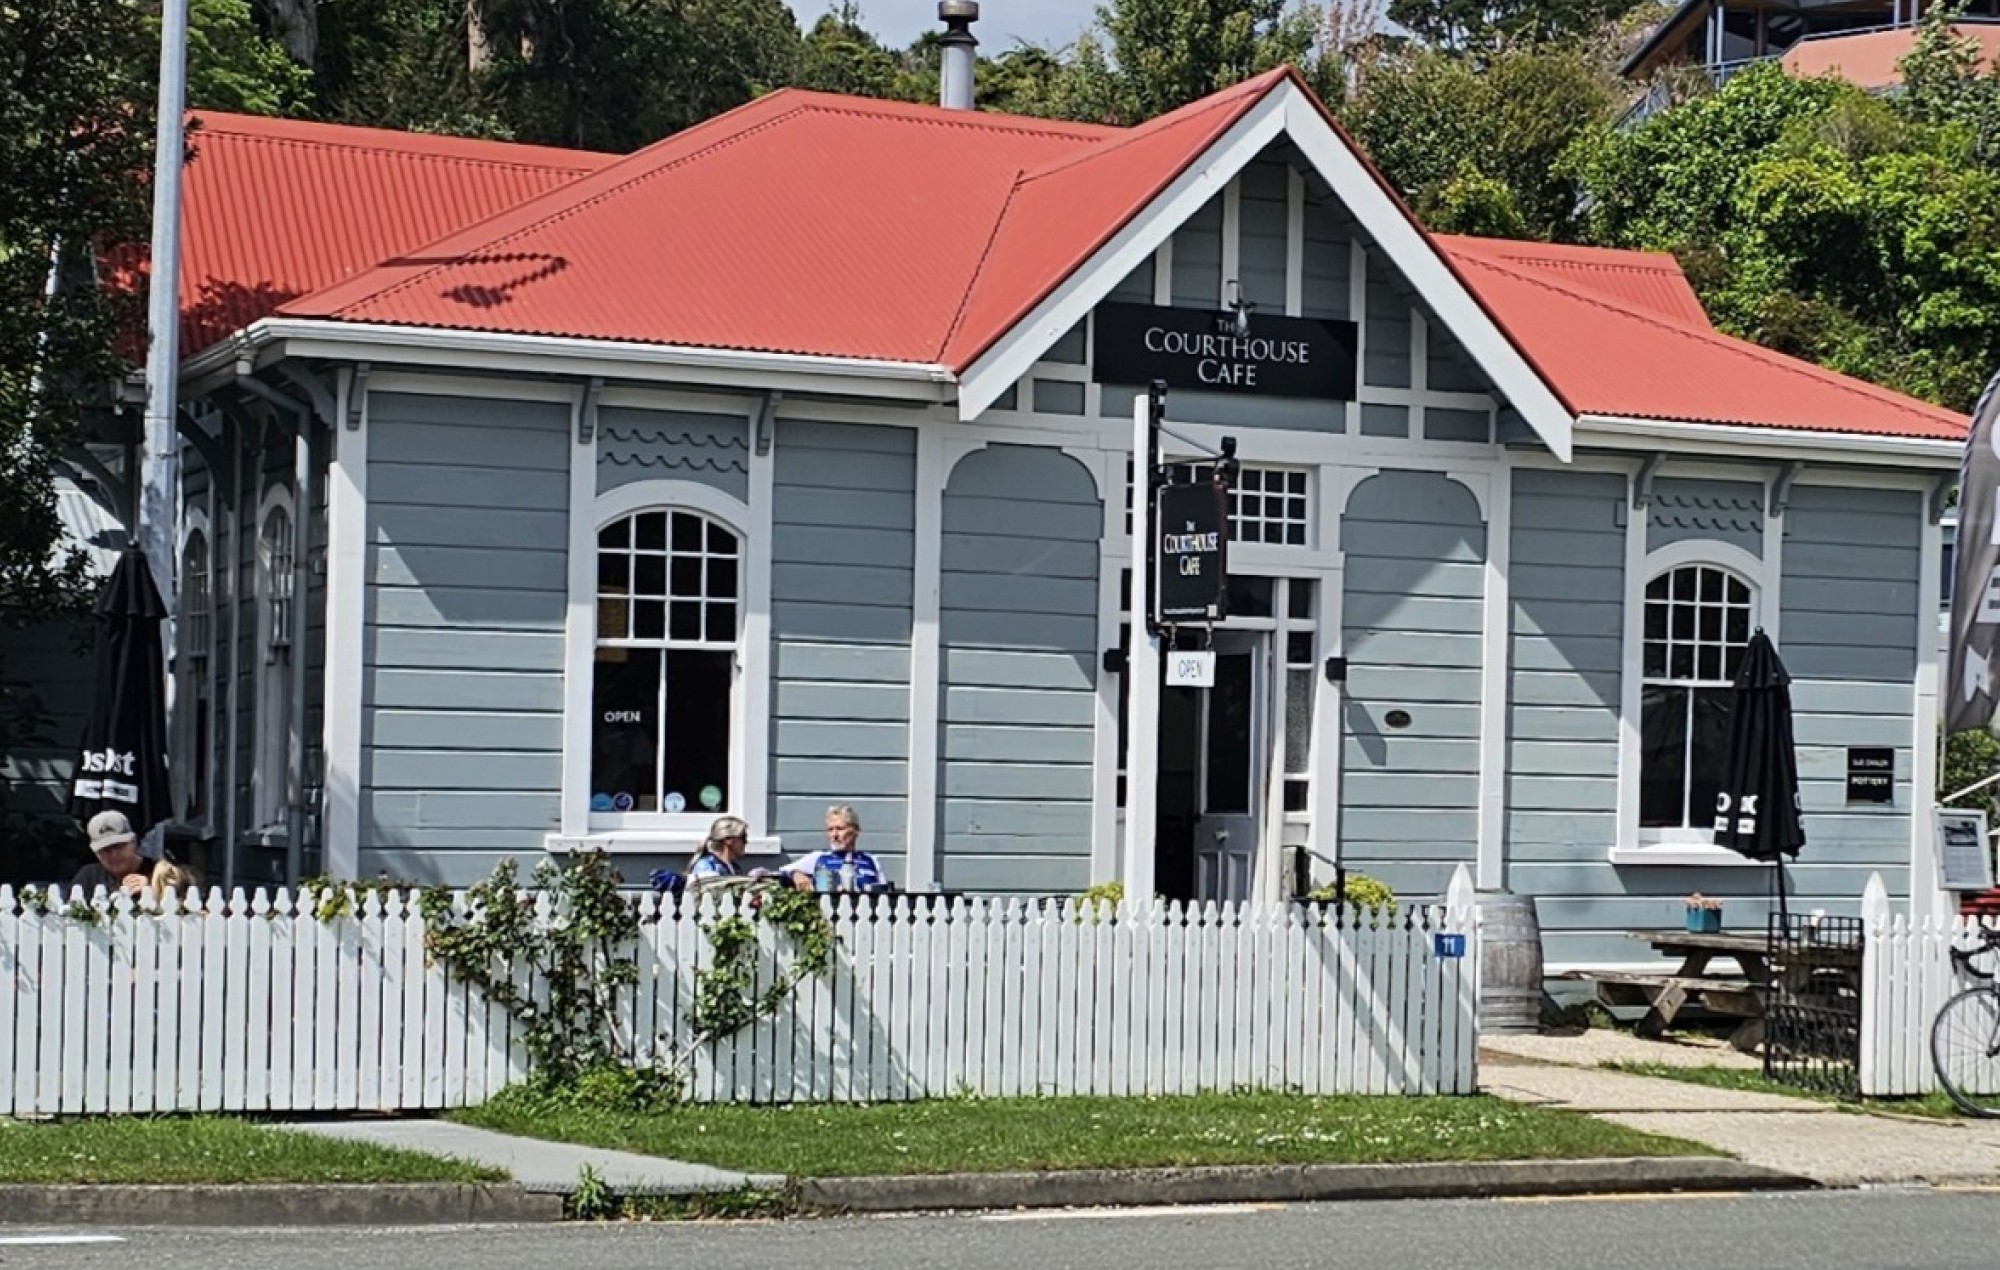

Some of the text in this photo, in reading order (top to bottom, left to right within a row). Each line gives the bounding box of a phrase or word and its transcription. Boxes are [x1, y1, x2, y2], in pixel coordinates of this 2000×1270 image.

[1217, 319, 1245, 332] TH
[1145, 327, 1309, 363] COURTHOUSE
[1197, 358, 1257, 386] CAFE
[1164, 532, 1218, 553] COURTHOUSE
[1180, 555, 1200, 575] CAFE
[1178, 659, 1203, 678] OPEN
[604, 711, 641, 722] OPEN
